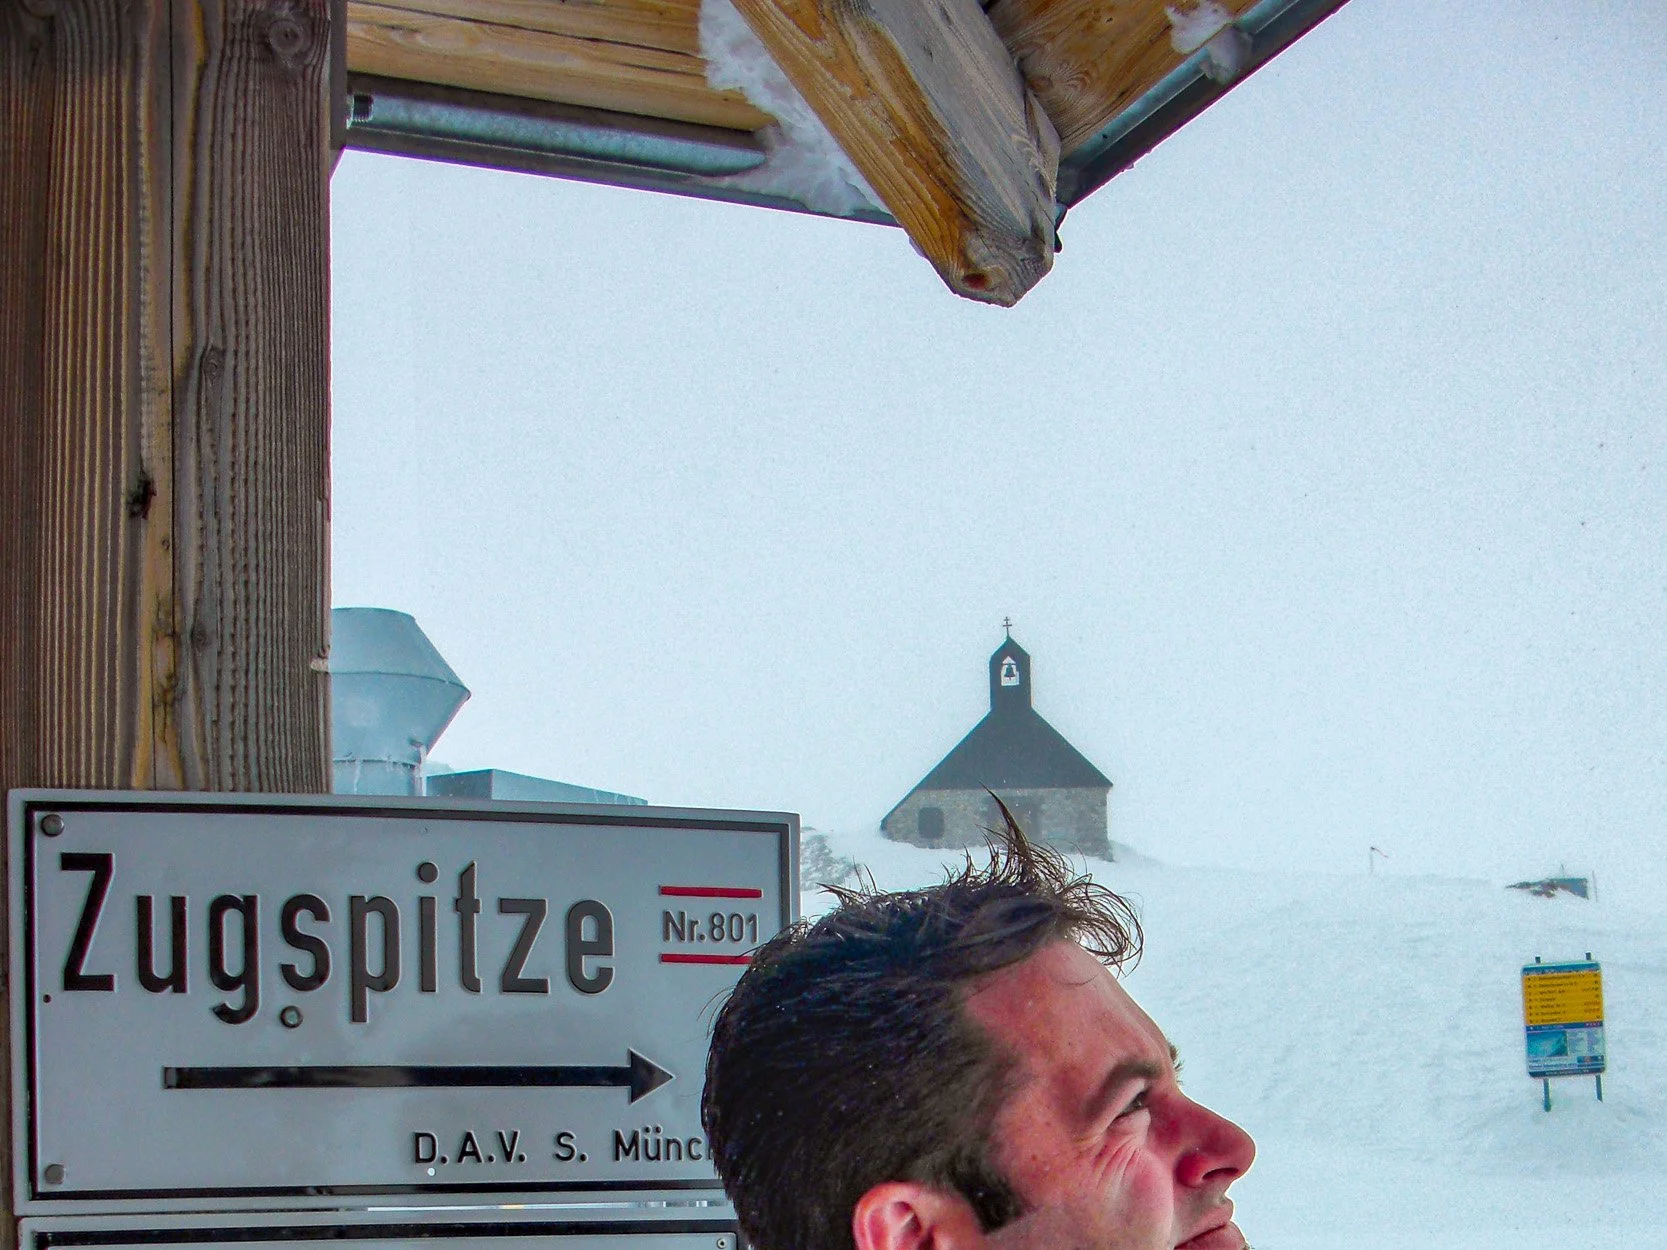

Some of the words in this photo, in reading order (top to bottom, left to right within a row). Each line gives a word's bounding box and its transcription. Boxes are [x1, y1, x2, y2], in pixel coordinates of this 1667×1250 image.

[60, 851, 616, 1025] Zugspitze
[663, 910, 760, 943] Nr.801
[414, 1129, 527, 1164] D.A.V.
[555, 1130, 589, 1163] S.
[614, 1124, 714, 1162] Münc
